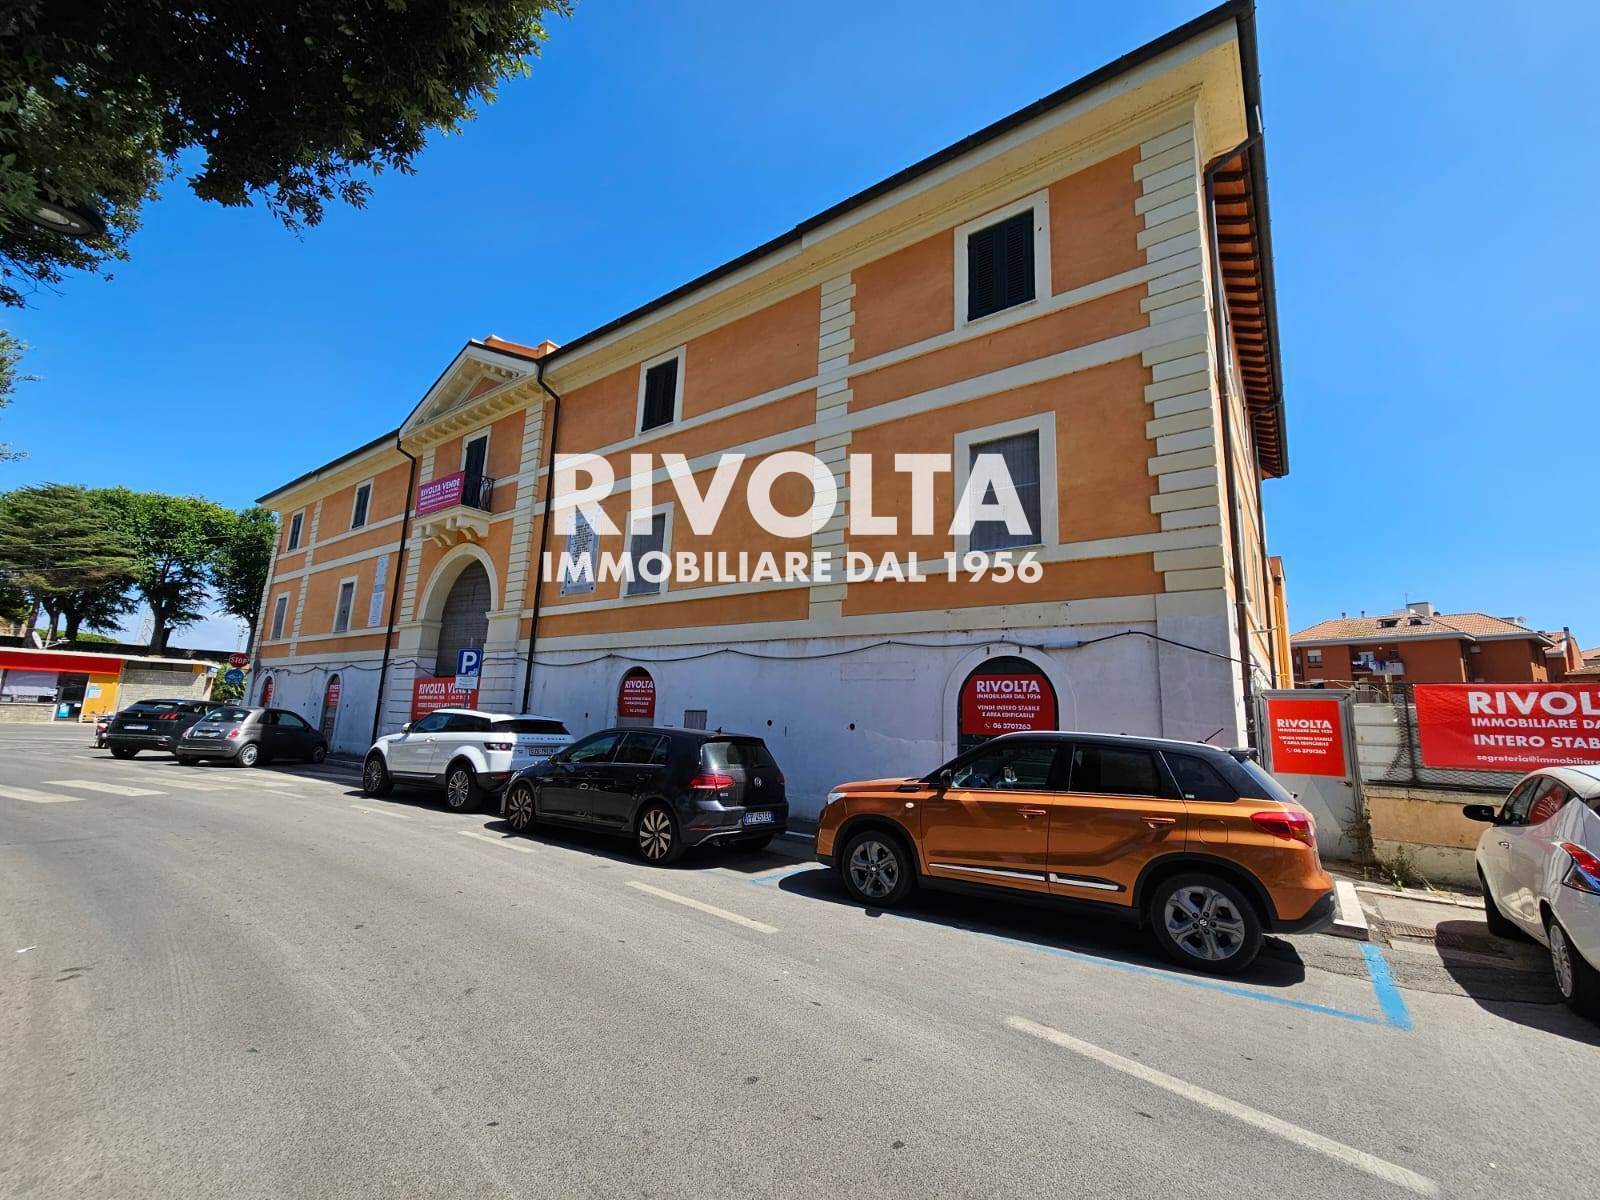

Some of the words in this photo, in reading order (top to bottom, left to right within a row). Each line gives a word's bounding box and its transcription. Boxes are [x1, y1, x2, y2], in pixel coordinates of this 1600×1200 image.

[230, 656, 249, 665] STOP
[461, 651, 478, 674] P
[418, 683, 445, 694] RIVOLTA
[624, 680, 654, 689] RIVOLTA
[976, 680, 1041, 693] RIVOLTA
[1467, 691, 1600, 716] RIVOL
[1276, 718, 1333, 729] RIVOLTA
[1471, 717, 1578, 729] IMMOBILIARE
[1473, 734, 1546, 747] INTERO
[1551, 736, 1600, 749] STAB
